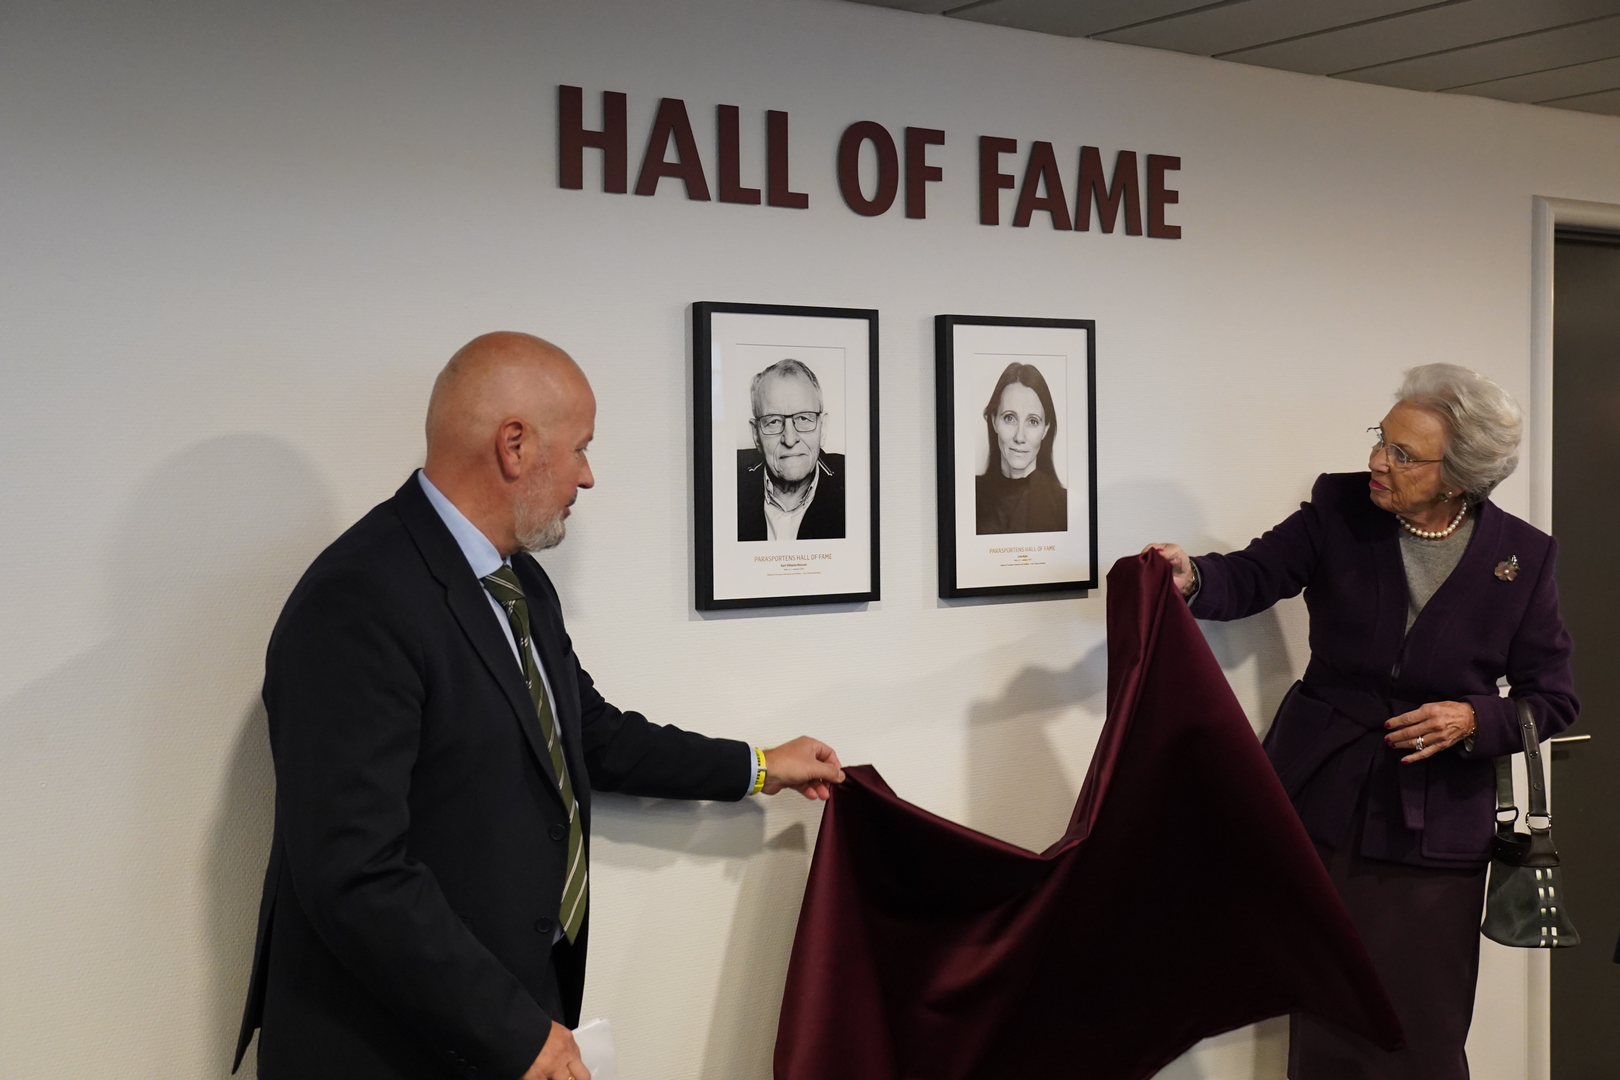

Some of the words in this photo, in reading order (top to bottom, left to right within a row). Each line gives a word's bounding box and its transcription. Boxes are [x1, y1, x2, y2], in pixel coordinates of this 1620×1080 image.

[558, 84, 809, 209] HALL
[836, 120, 945, 219] OF
[979, 135, 1182, 240] FAME
[989, 546, 1025, 554] PARASPORTENS
